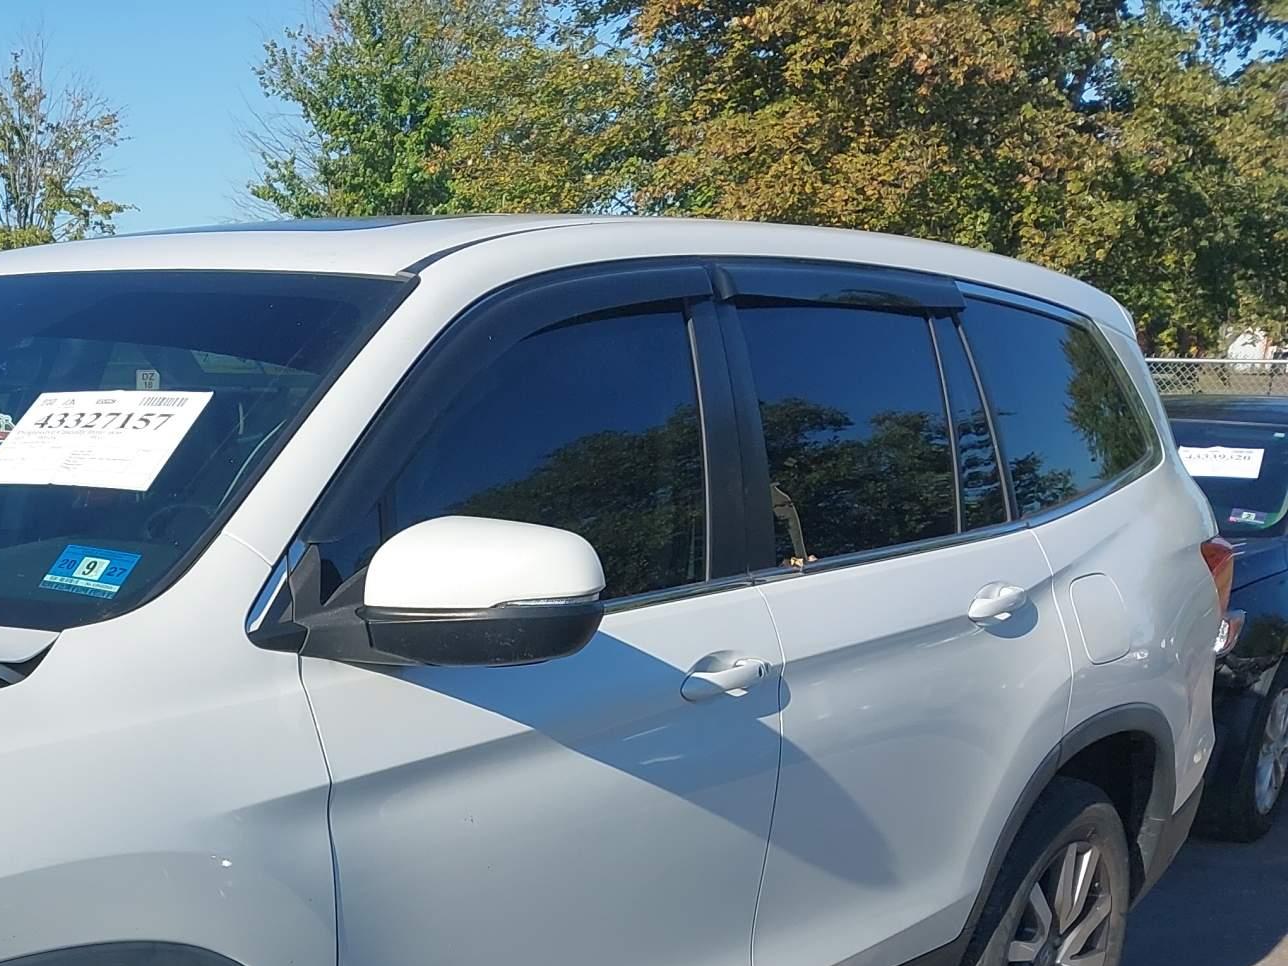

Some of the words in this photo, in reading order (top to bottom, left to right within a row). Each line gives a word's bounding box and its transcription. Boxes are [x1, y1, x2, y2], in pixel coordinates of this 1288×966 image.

[141, 372, 155, 381] DZ
[34, 412, 176, 431] 43327157
[58, 558, 77, 570] 20
[82, 560, 98, 576] 9
[106, 566, 128, 578] 27
